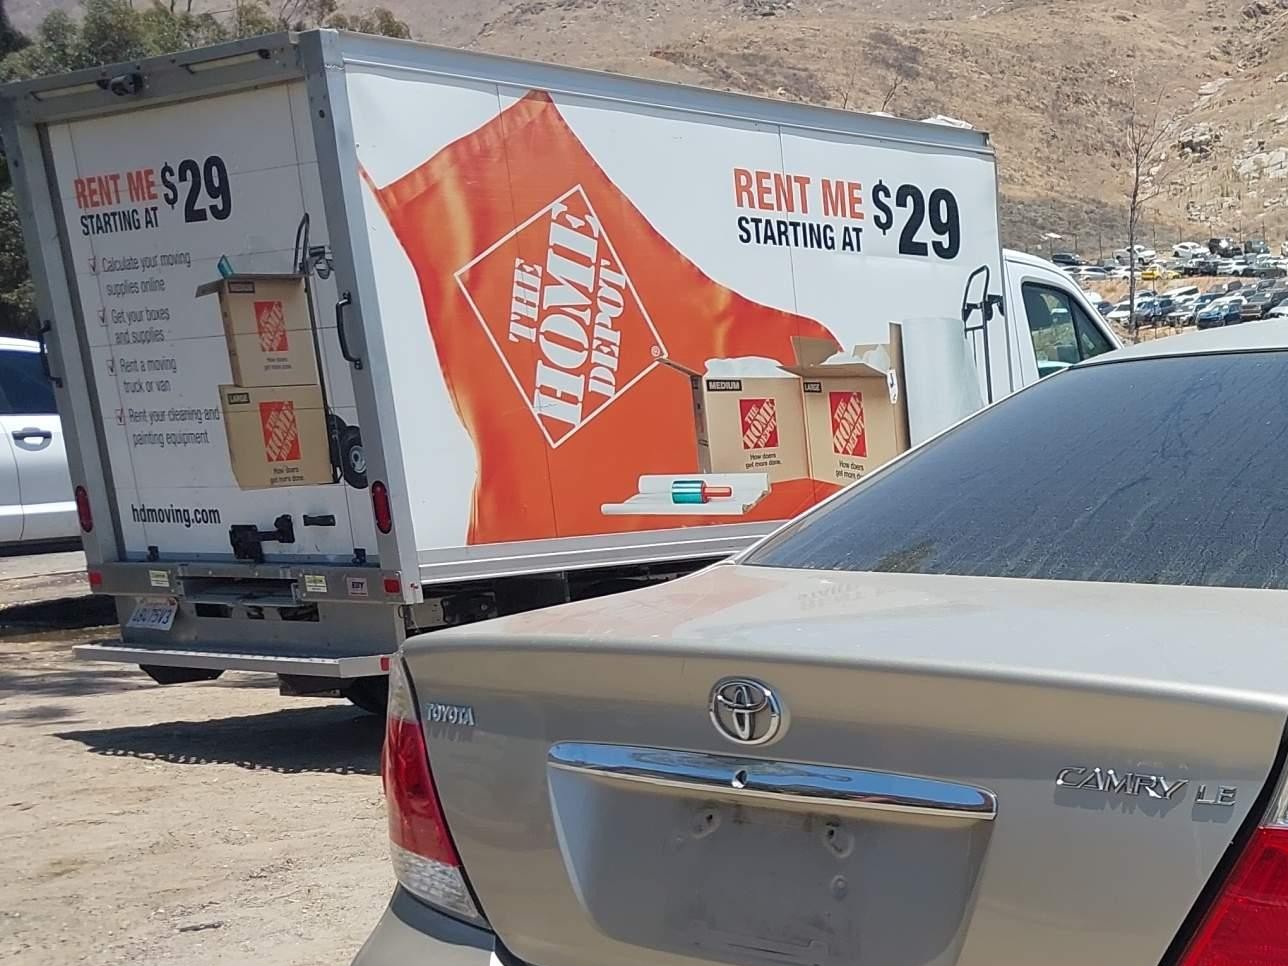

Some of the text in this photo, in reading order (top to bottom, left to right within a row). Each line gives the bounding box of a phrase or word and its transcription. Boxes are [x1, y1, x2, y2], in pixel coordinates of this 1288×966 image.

[74, 155, 232, 223] RENT ME $29
[80, 206, 159, 236] STARTING AT
[733, 167, 961, 260] RENT ME $29
[737, 216, 864, 252] STARTING AT
[102, 252, 191, 272] Calculate your moving
[106, 276, 166, 297] supplies online
[508, 256, 543, 343] THE
[111, 306, 170, 326] Get your boxes
[533, 200, 602, 428] HOME
[114, 326, 165, 345] and supplies
[587, 257, 627, 399] DEPOT
[120, 356, 177, 373] Rent a moving
[123, 380, 171, 393] truck or van
[709, 381, 740, 390] MEDIUM
[127, 406, 220, 425] Rent your cleaning and
[132, 430, 209, 448] painting equipment
[130, 503, 221, 528] hdmoving.com
[424, 703, 475, 726] TOYOTA
[1055, 767, 1239, 807] CAMRY LE
